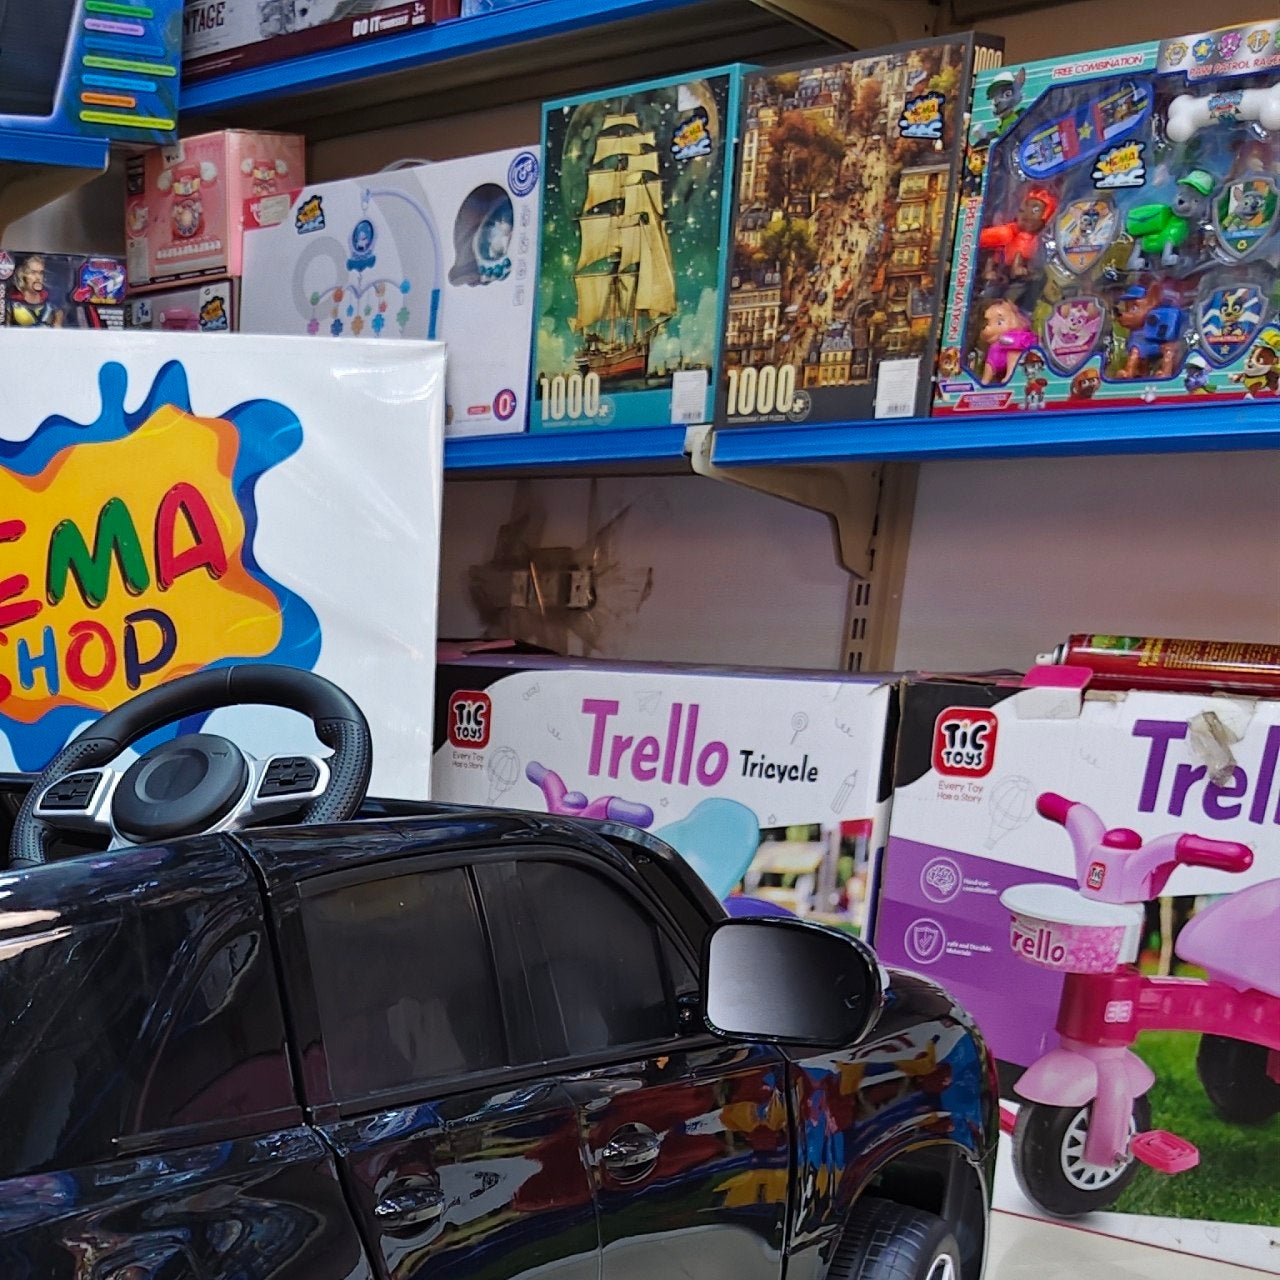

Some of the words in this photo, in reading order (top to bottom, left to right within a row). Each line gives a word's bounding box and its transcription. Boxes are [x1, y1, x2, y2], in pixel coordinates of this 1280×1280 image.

[1051, 65, 1074, 79] FREE
[1074, 53, 1144, 75] COMBINATION
[541, 372, 600, 421] 1000
[727, 365, 796, 416] 1000
[582, 698, 729, 787] Trello
[739, 749, 819, 784] Tricycle
[938, 780, 965, 791] Every
[967, 782, 984, 794] Toy
